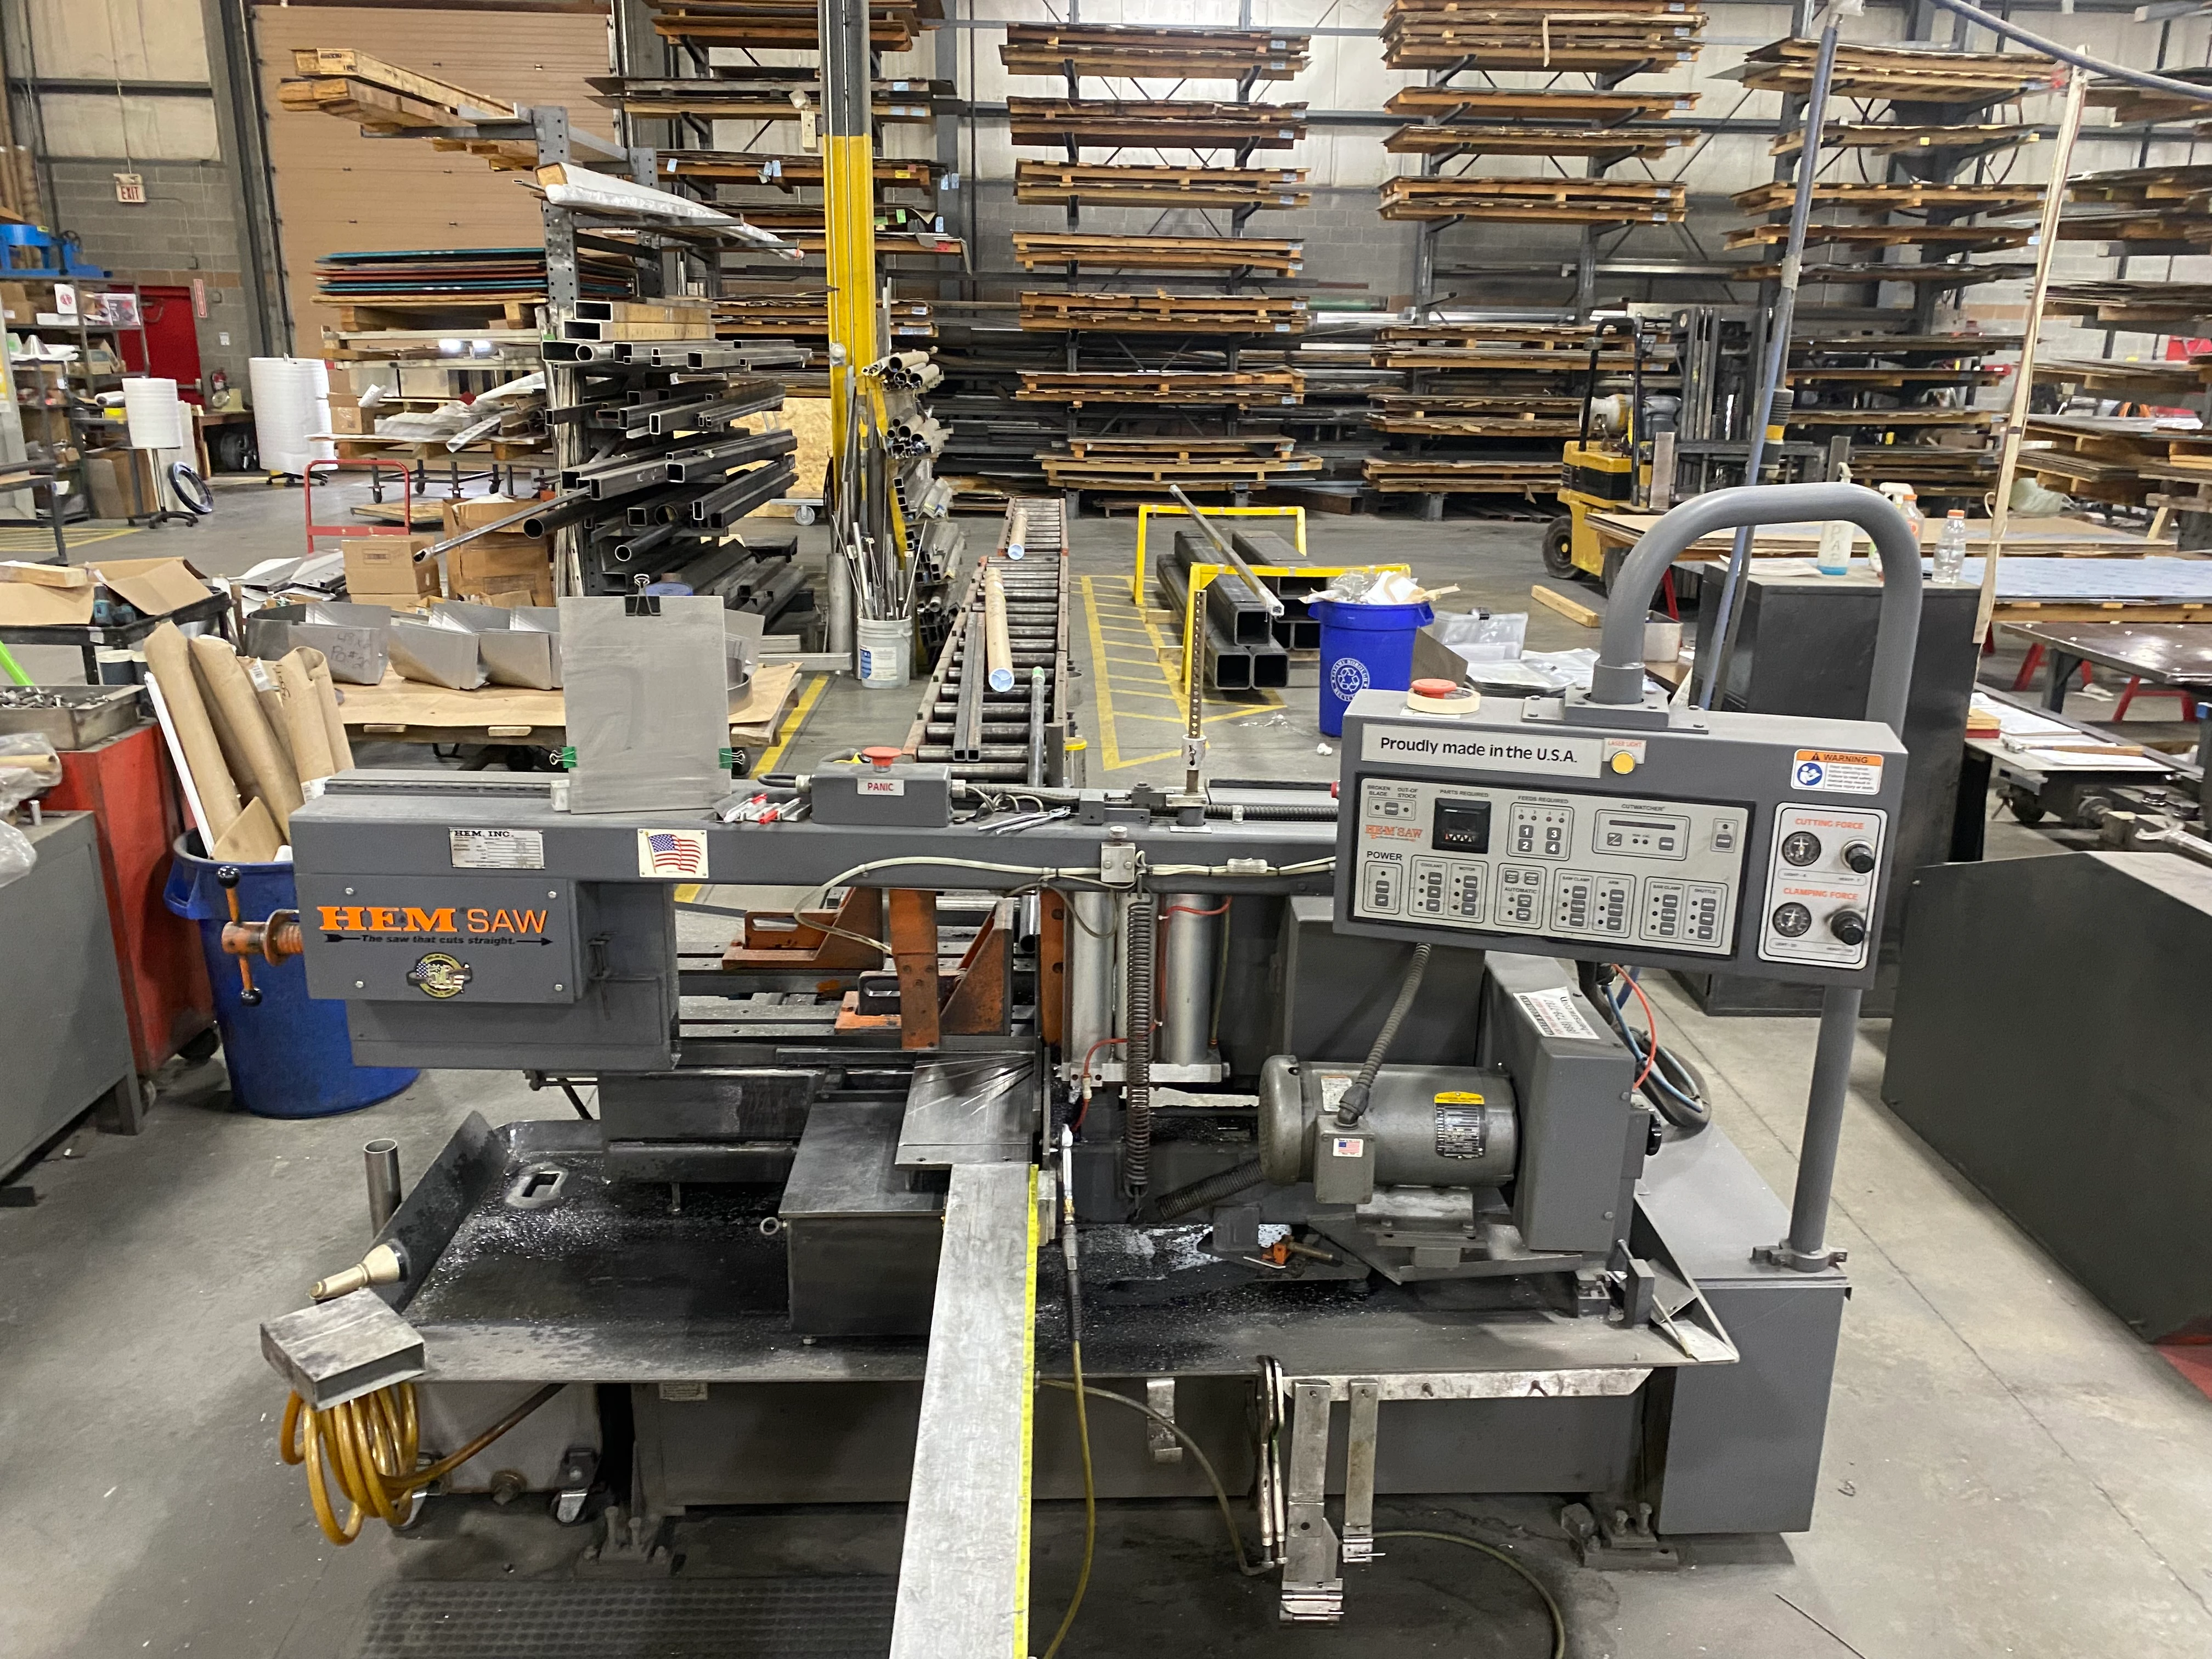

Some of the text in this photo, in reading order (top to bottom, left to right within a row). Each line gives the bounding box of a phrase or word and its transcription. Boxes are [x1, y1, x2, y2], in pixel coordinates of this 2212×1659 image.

[121, 187, 139, 200] EXIT
[1380, 737, 1577, 763] Proudly made in the U.S.A.
[1824, 754, 1868, 763] WARNING
[867, 782, 894, 791] PANIC
[1795, 819, 1864, 830] CUTTING FORCE
[1367, 851, 1402, 861] POWER
[1784, 887, 1859, 900] CLAMPING FORCE
[466, 909, 548, 933] SAW
[361, 934, 383, 943] The
[413, 935, 436, 944] that
[467, 935, 515, 946] straight.
